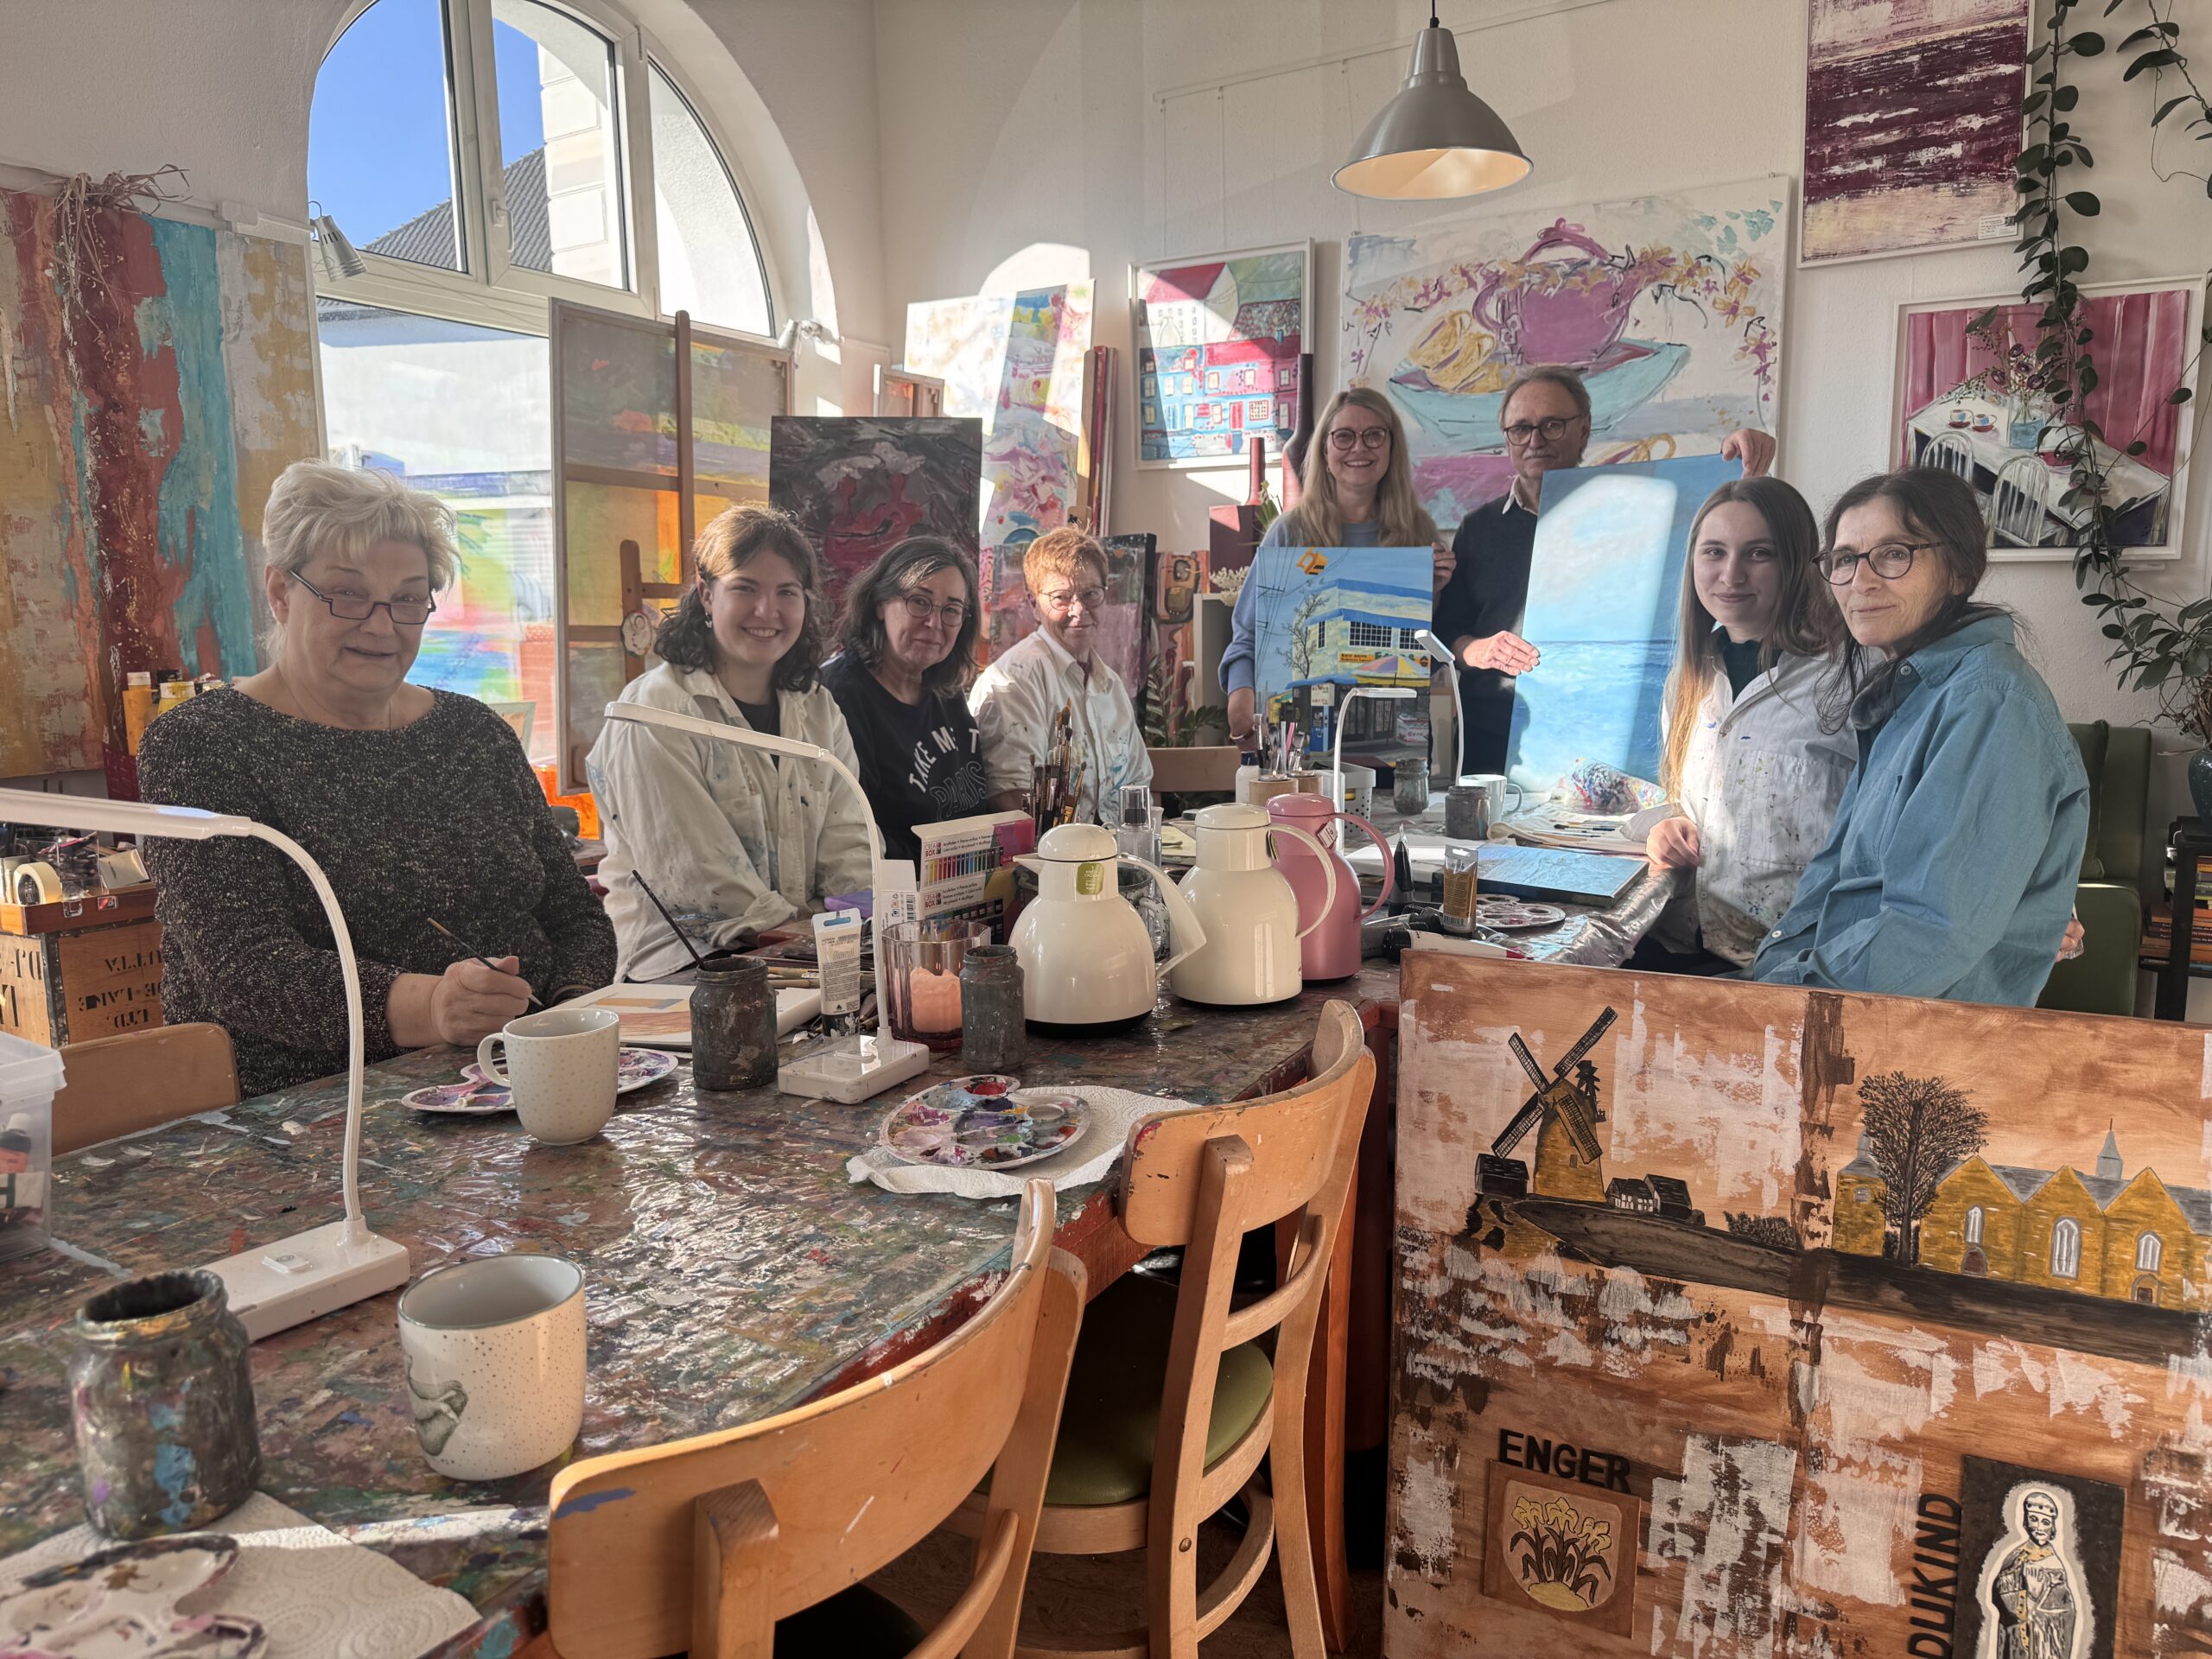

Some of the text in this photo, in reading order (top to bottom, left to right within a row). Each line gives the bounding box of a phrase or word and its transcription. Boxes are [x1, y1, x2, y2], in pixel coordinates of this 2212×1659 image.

[909, 741, 937, 793] TAKE
[929, 760, 988, 822] PARIS
[1498, 1427, 1631, 1494] ENGER
[1908, 1493, 1962, 1659] DUKIND
